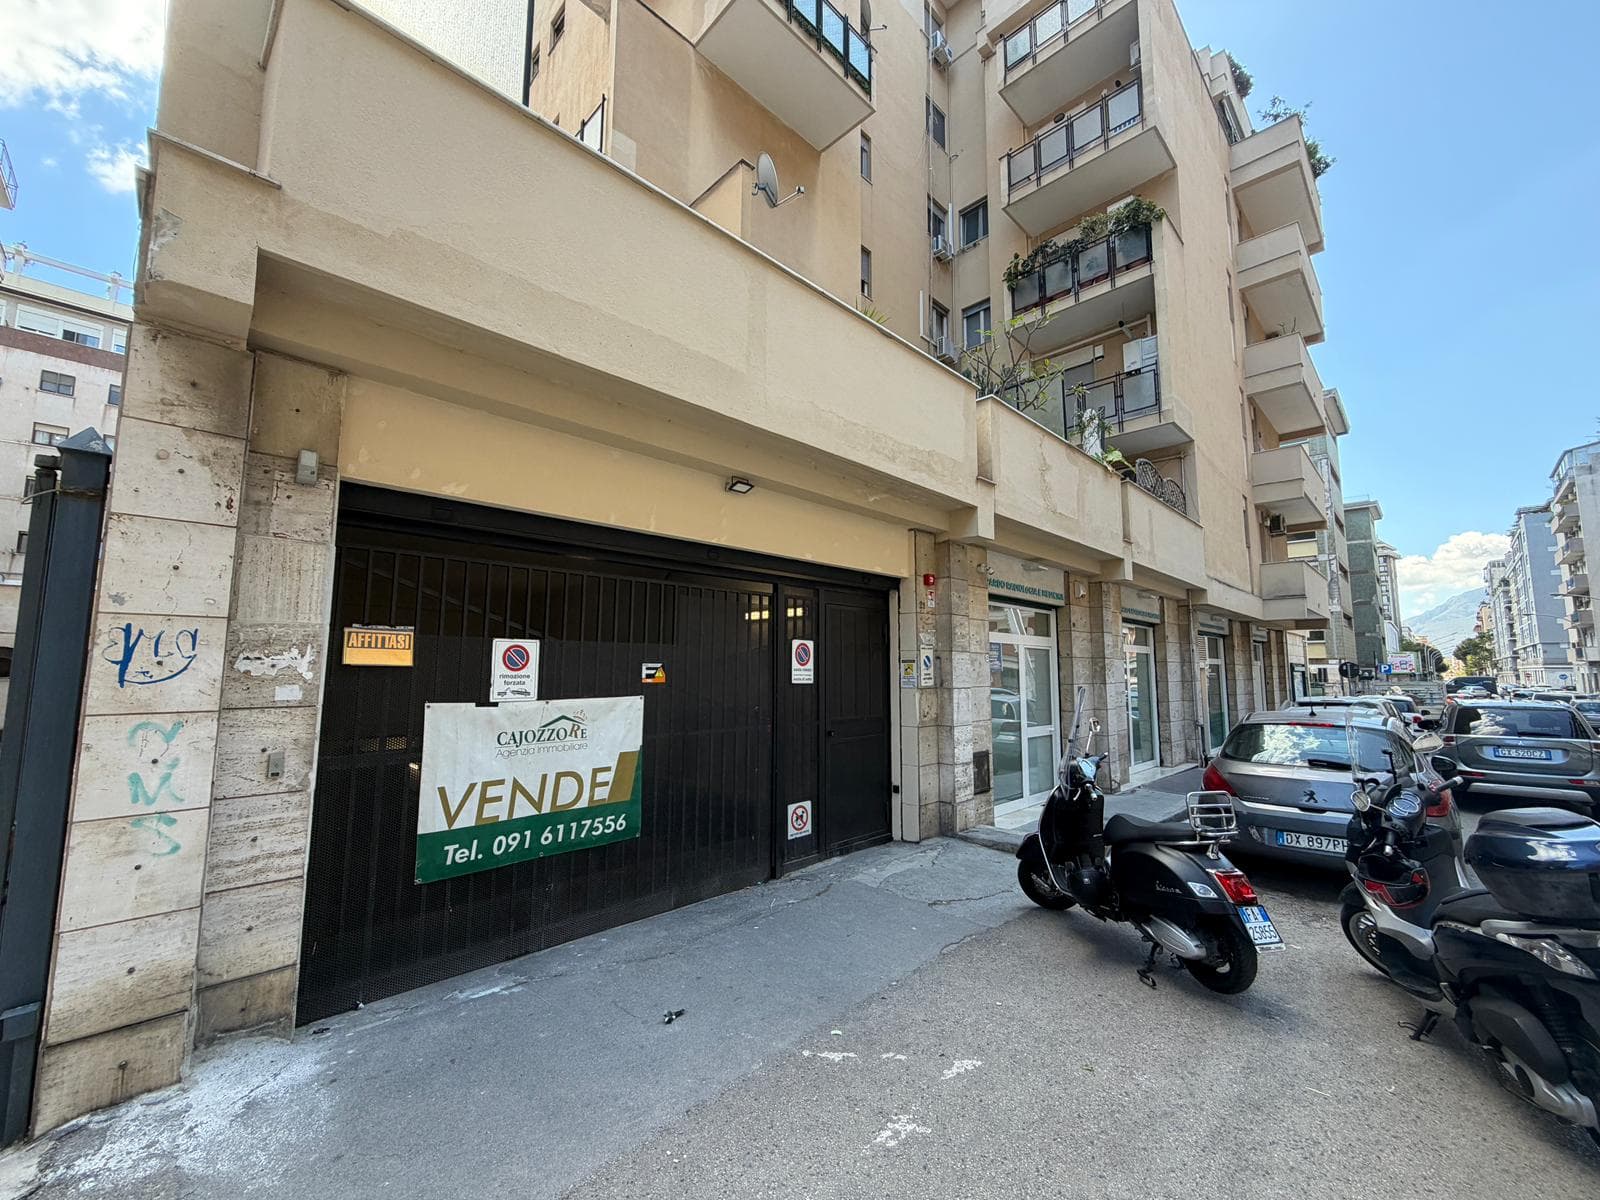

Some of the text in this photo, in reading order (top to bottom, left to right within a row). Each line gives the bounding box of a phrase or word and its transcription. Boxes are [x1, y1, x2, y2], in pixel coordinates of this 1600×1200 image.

[349, 632, 410, 648] AFFITTASI
[1381, 664, 1389, 673] P
[496, 747, 535, 759] Agenzia
[438, 766, 612, 830] VENDE
[444, 814, 627, 865] Tel. 091 6117556
[1286, 833, 1301, 846] DX
